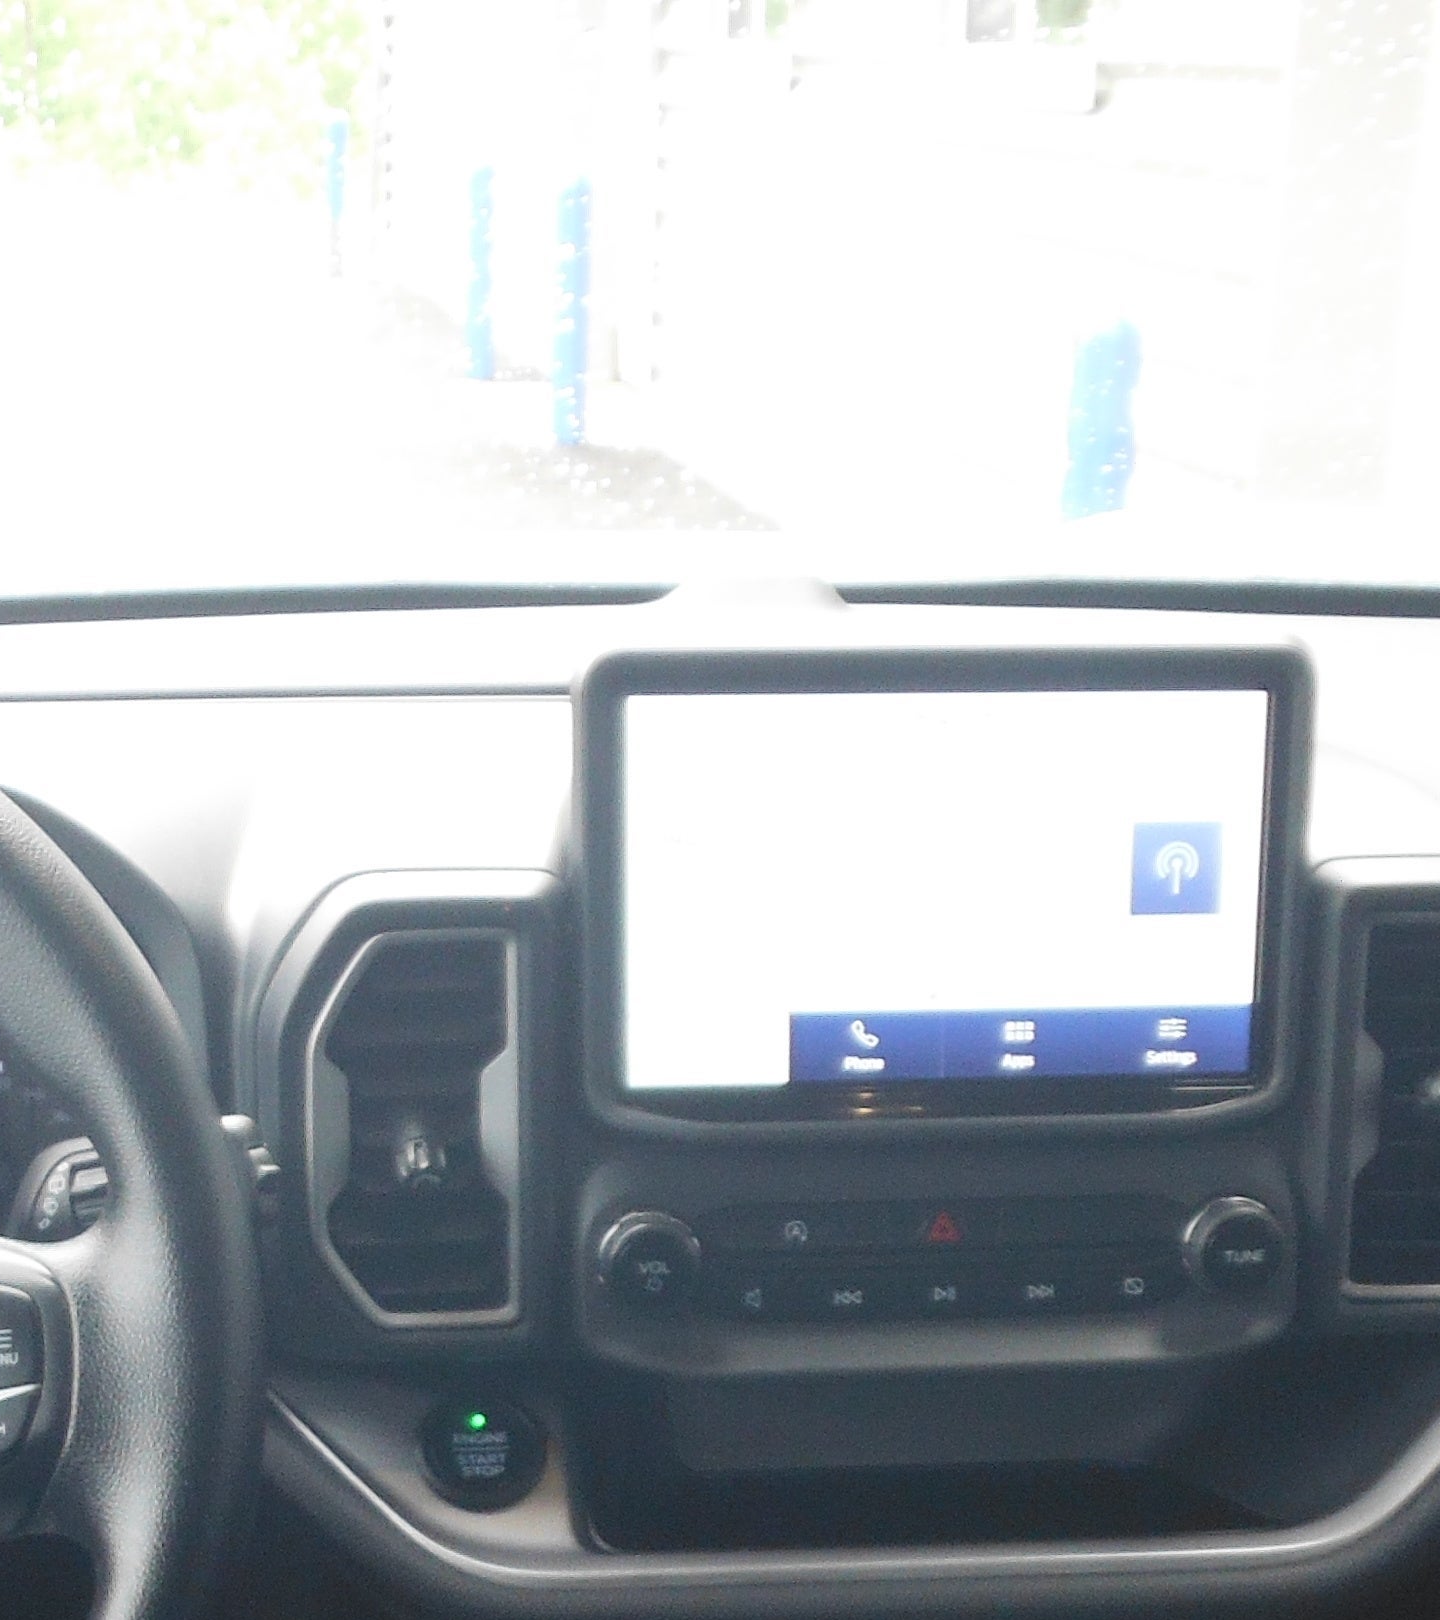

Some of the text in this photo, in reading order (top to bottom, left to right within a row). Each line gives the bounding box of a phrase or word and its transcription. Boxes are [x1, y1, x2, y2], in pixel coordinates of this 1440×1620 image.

[844, 1055, 885, 1071] Phone
[1001, 1053, 1036, 1070] Apps
[1145, 1050, 1198, 1067] Settings
